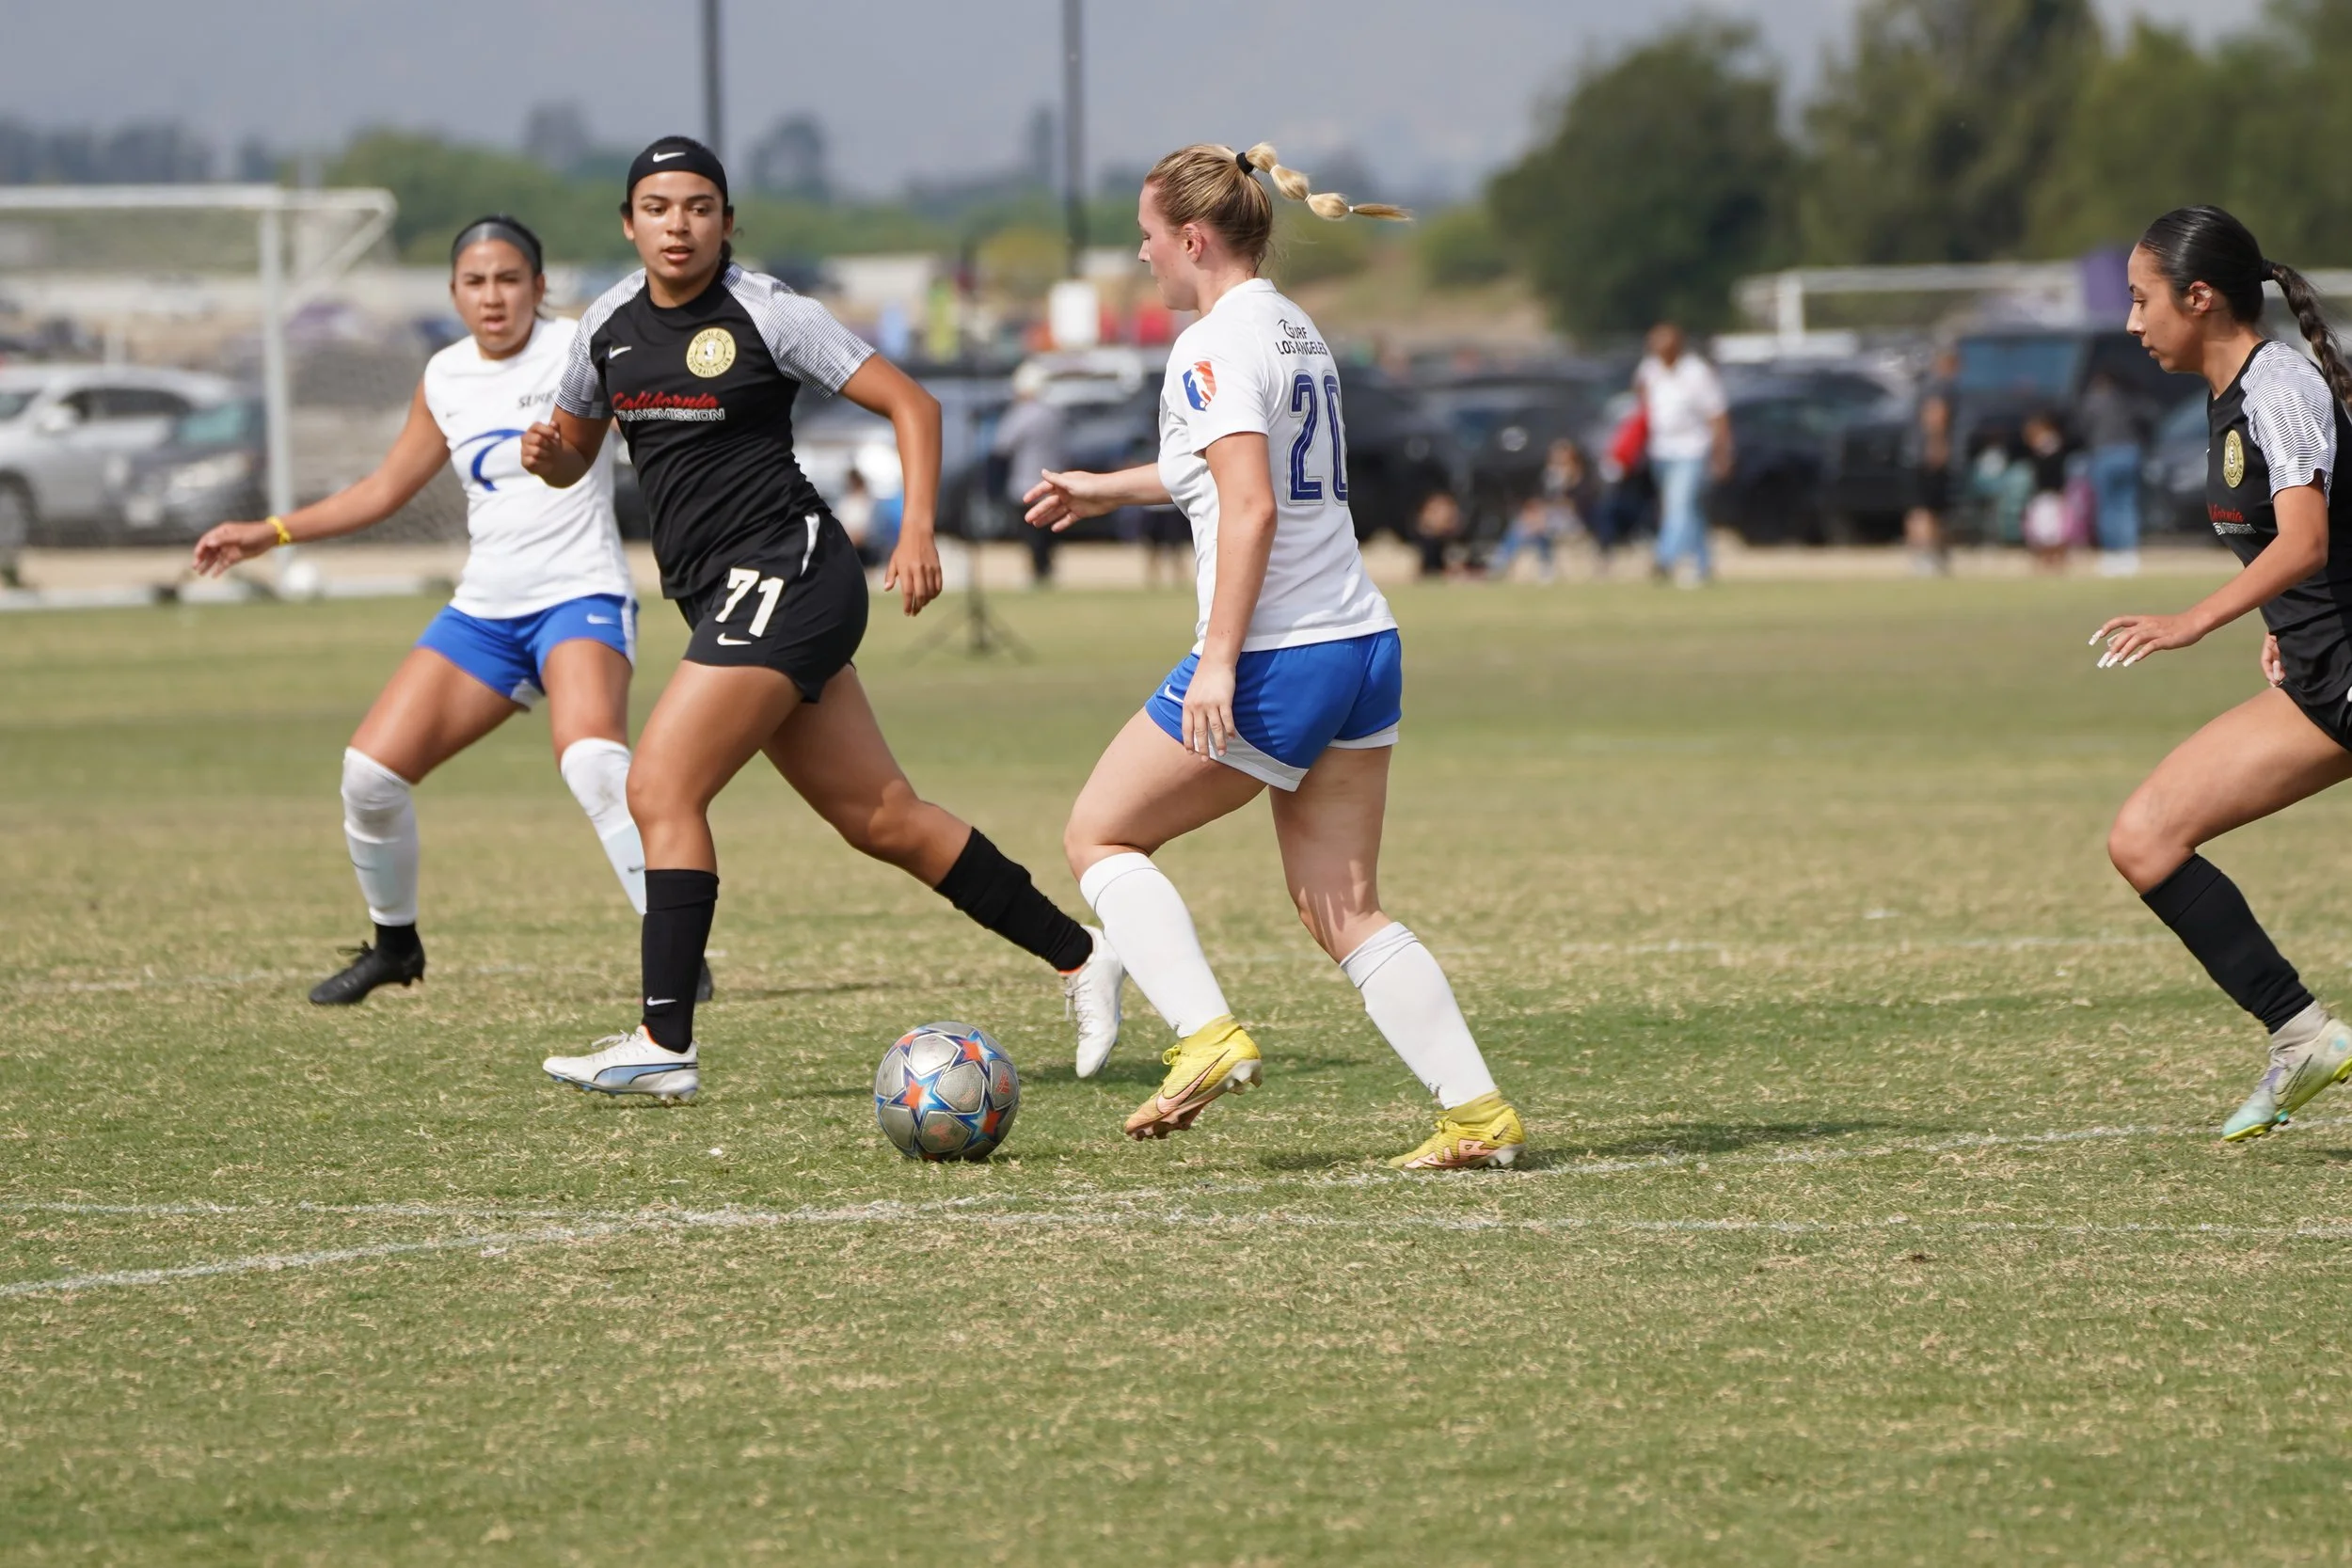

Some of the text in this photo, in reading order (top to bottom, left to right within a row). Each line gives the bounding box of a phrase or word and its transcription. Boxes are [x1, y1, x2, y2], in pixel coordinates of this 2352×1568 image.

[1275, 341, 1327, 356] LOS ANGELES
[612, 390, 720, 409] California
[614, 407, 725, 421] TRANSMISSION
[715, 568, 784, 637] 71
